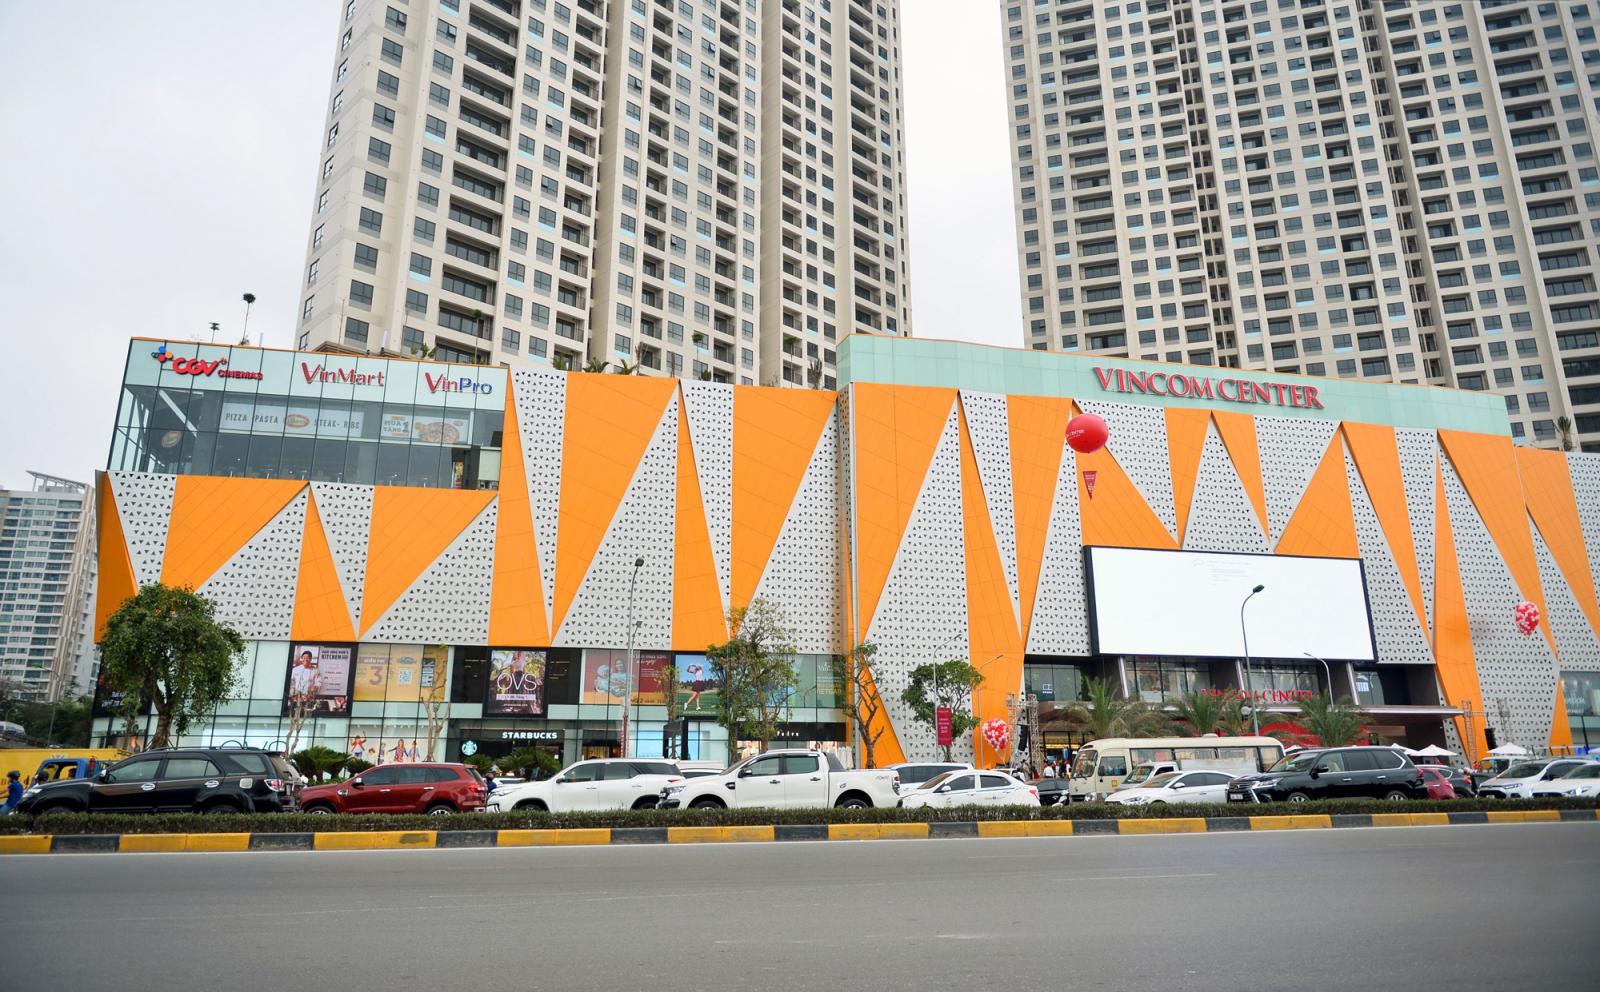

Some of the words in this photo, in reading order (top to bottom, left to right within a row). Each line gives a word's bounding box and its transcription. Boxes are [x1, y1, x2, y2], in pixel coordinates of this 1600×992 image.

[172, 357, 220, 377] CGV
[301, 362, 385, 387] VinMart
[424, 372, 493, 394] VinPro
[1092, 366, 1215, 399] VINCOM
[1218, 378, 1325, 409] CENTER
[225, 412, 247, 422] PIZZA
[254, 414, 279, 424] PASTA
[343, 420, 360, 430] RBS
[496, 672, 537, 691] OVS
[502, 731, 558, 739] STARBUCKS
